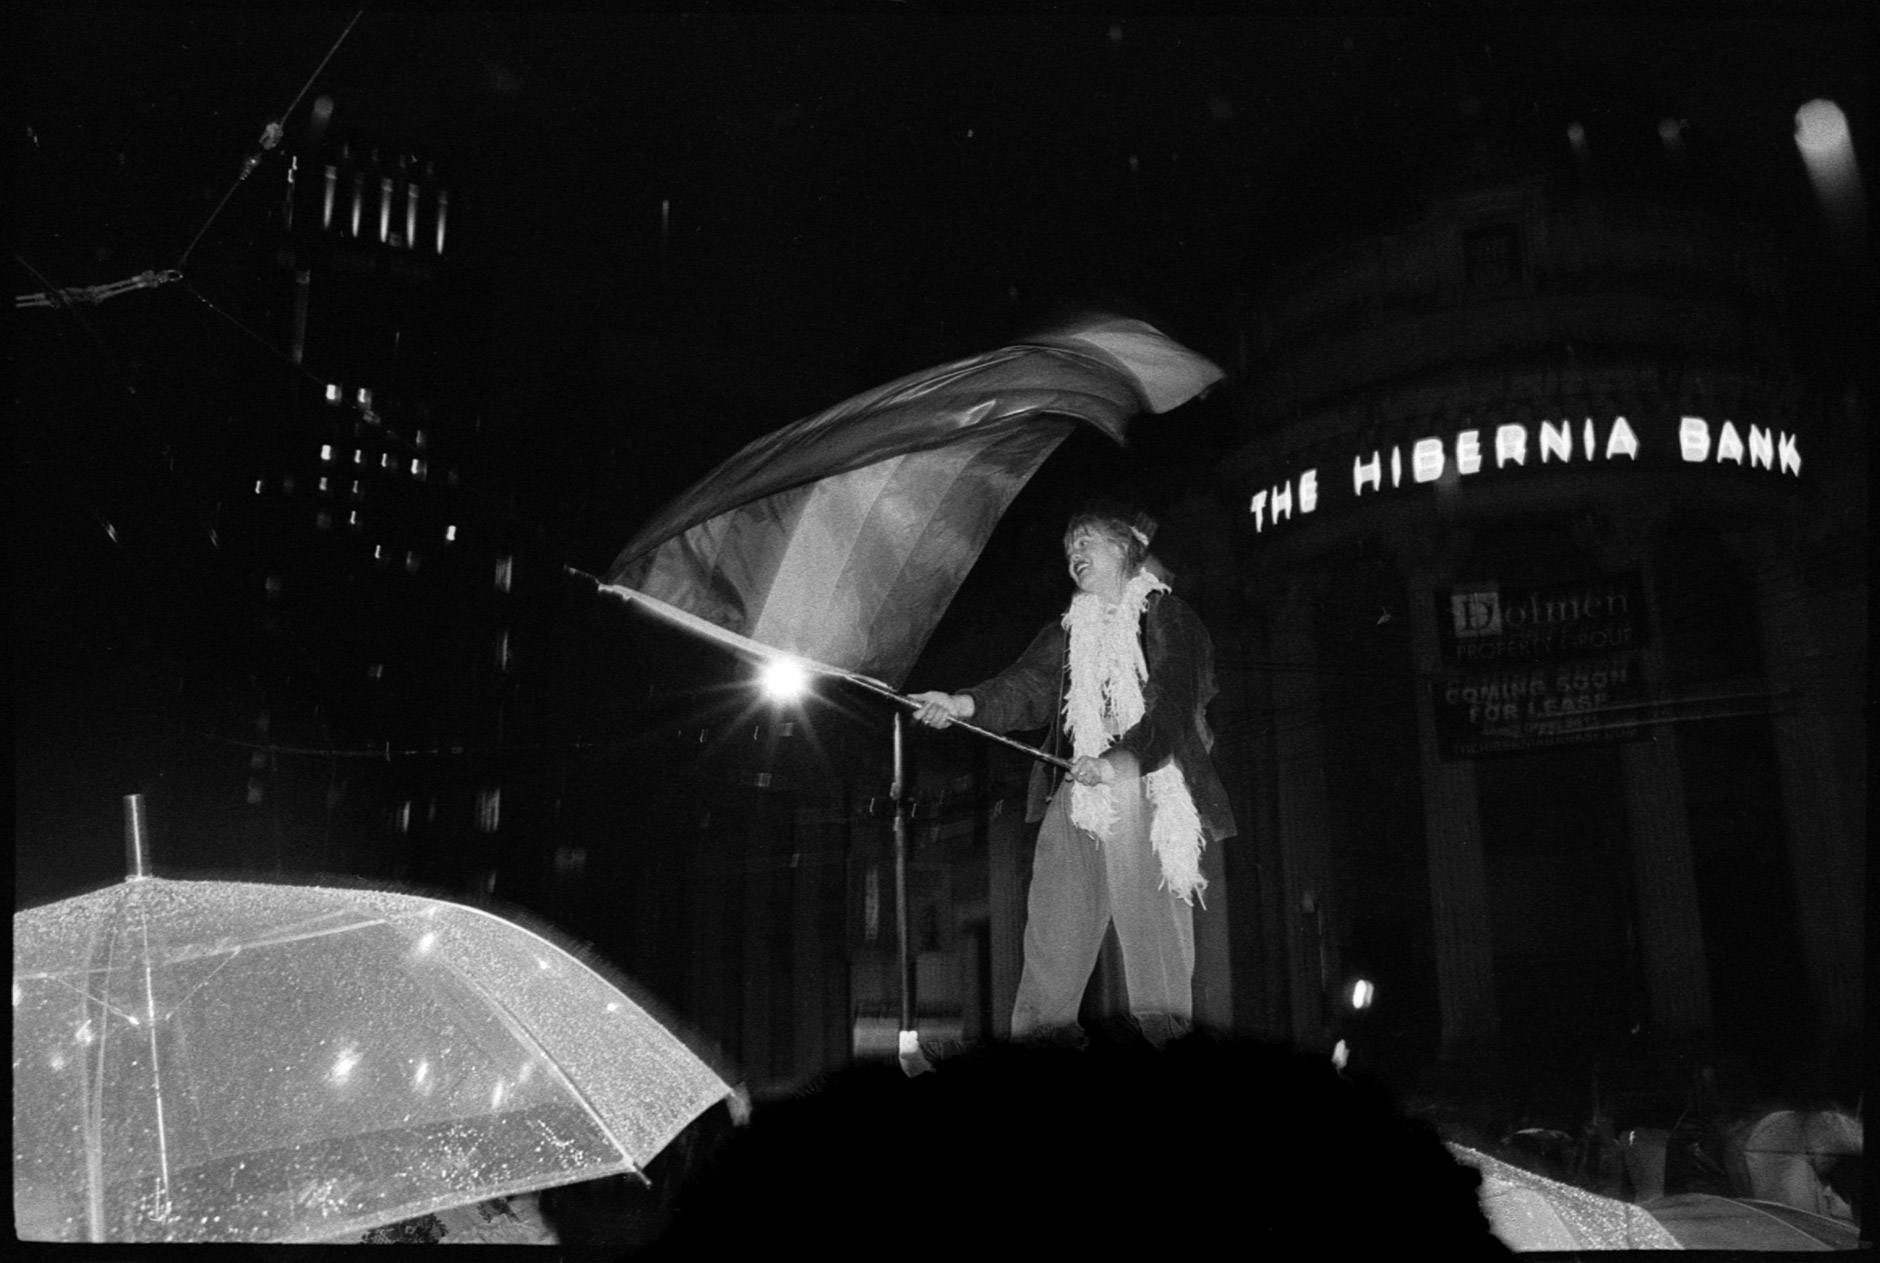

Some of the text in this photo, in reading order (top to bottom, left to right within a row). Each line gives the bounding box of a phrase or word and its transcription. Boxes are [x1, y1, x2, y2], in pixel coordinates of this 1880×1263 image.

[1250, 416, 1801, 533] THE HIBERNIA BANK
[1457, 591, 1628, 633] Dolmen
[1457, 633, 1553, 659] PROPERTY
[1445, 668, 1628, 705] COMING SOON
[1469, 692, 1609, 724] FOR LEASE
